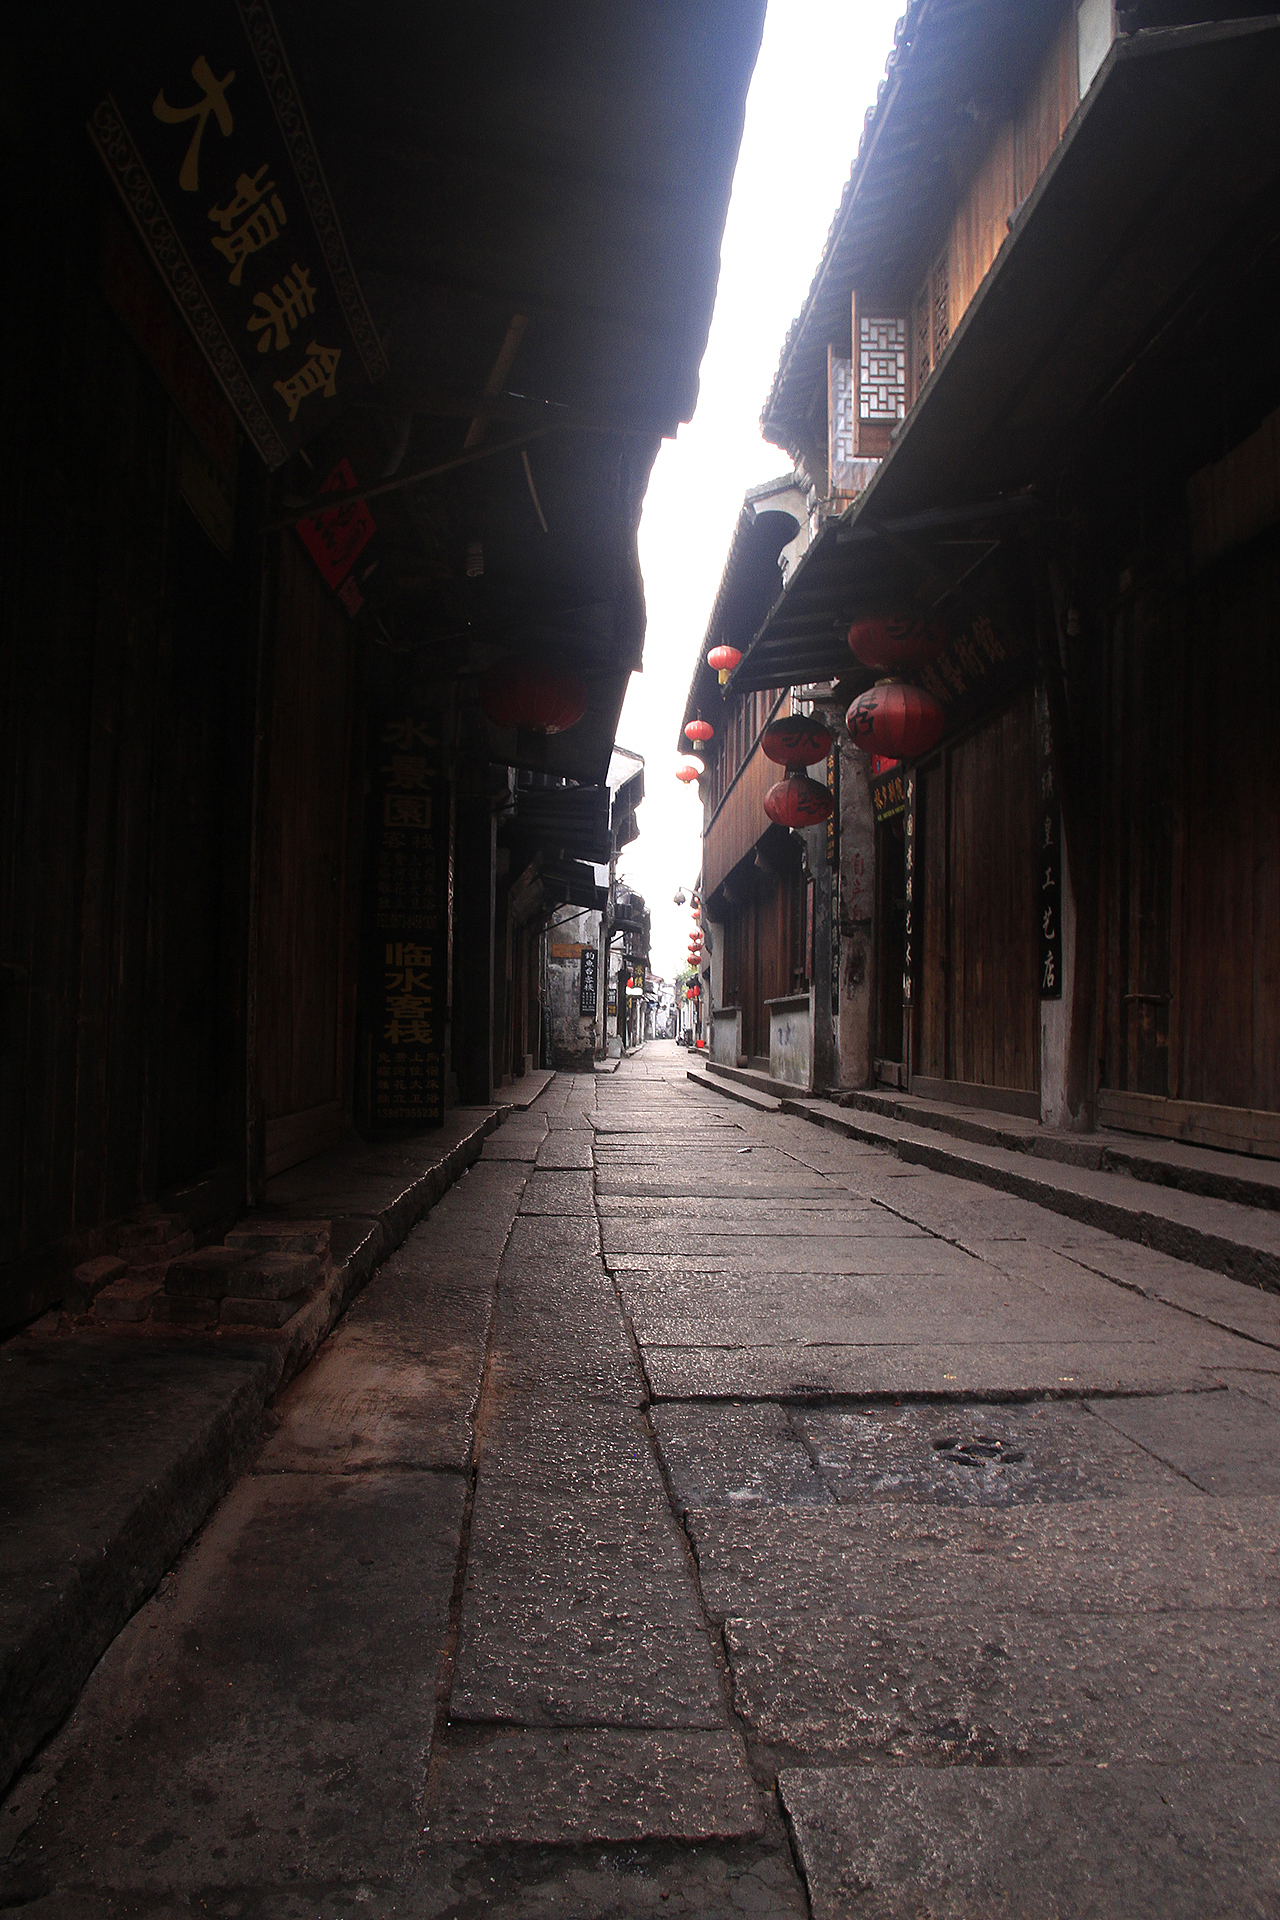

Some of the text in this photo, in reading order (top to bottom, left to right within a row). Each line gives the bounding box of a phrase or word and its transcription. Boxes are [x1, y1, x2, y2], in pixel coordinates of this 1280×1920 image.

[151, 54, 344, 423] 大娘美食
[384, 942, 433, 1045] 临水客栈
